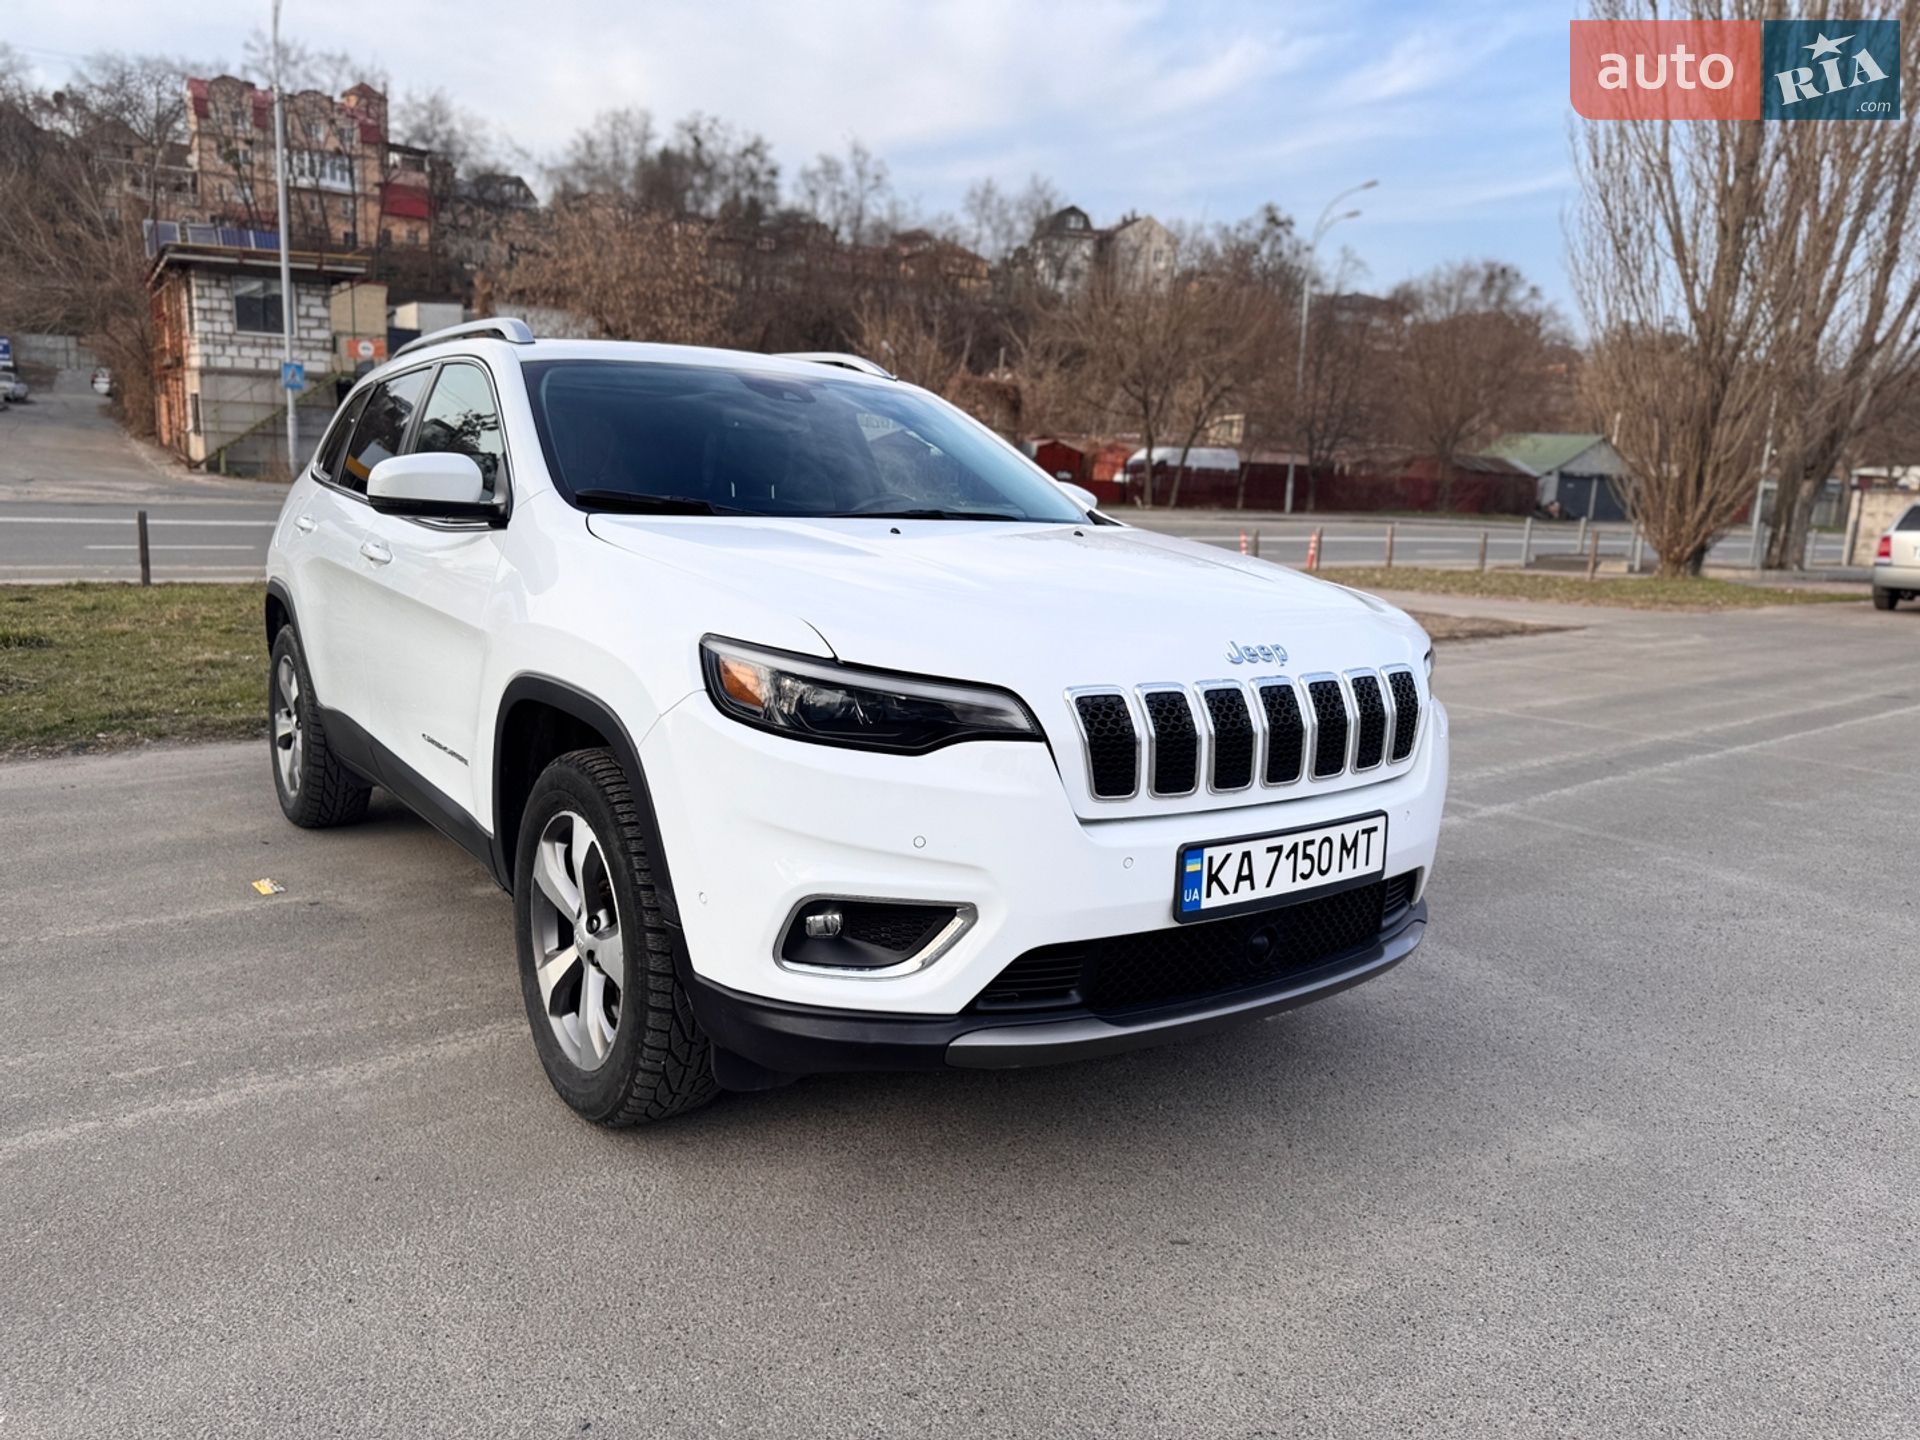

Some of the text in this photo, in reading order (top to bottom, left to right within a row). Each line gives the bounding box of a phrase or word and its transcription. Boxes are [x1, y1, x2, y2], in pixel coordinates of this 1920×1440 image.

[1224, 640, 1288, 667] Jeep
[1205, 826, 1379, 899] KA 7150 MT
[1183, 888, 1200, 902] UA
